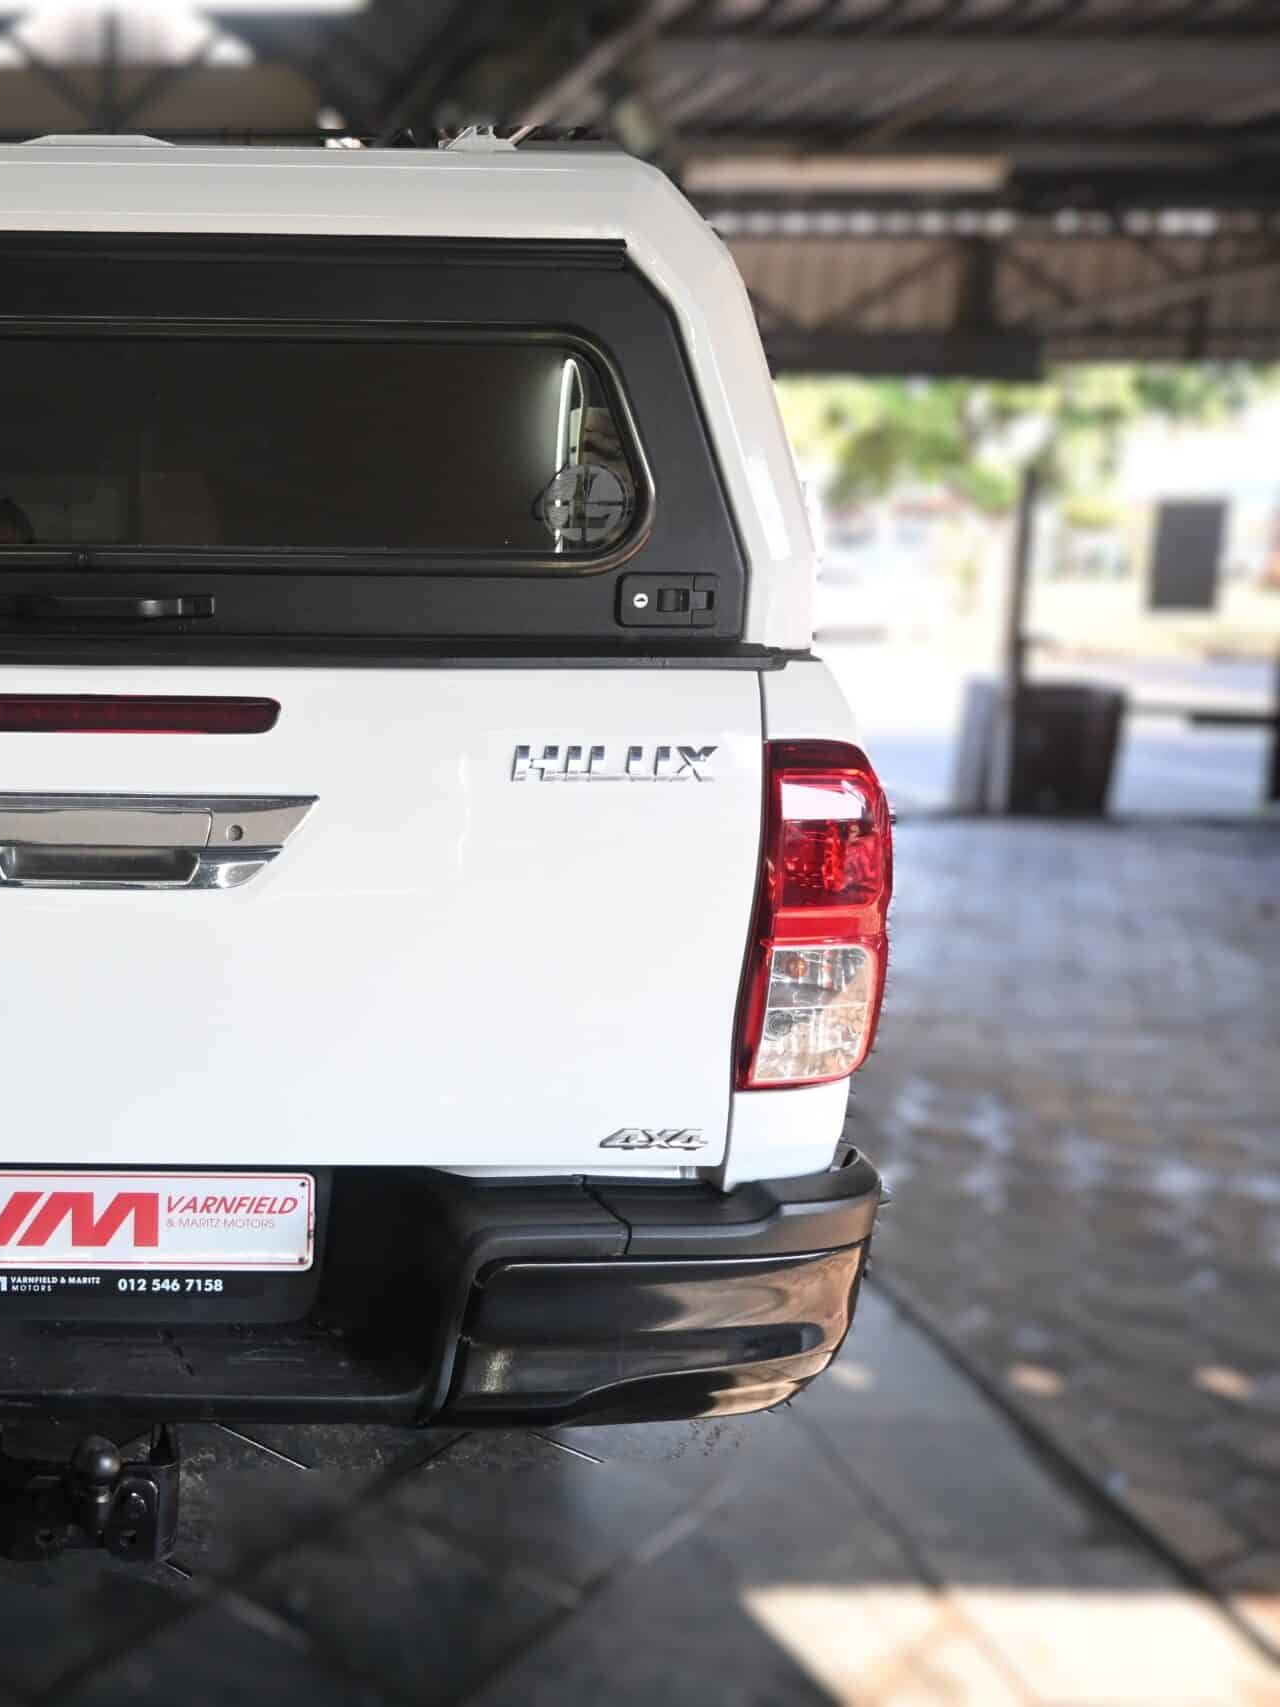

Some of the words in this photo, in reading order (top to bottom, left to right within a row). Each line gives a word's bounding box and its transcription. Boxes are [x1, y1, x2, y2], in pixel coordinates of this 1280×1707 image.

[510, 744, 719, 783] HILUX
[166, 1195, 298, 1215] VARNFIELD
[166, 1219, 175, 1228] &
[178, 1218, 220, 1229] MARITZ
[223, 1218, 275, 1230] MOTORS
[10, 1276, 58, 1285] VARNFIELD
[68, 1277, 100, 1286] MARITZ
[118, 1278, 147, 1292] 012
[151, 1279, 181, 1292] 546
[184, 1279, 224, 1293] 7158
[11, 1284, 53, 1293] MOTORS
